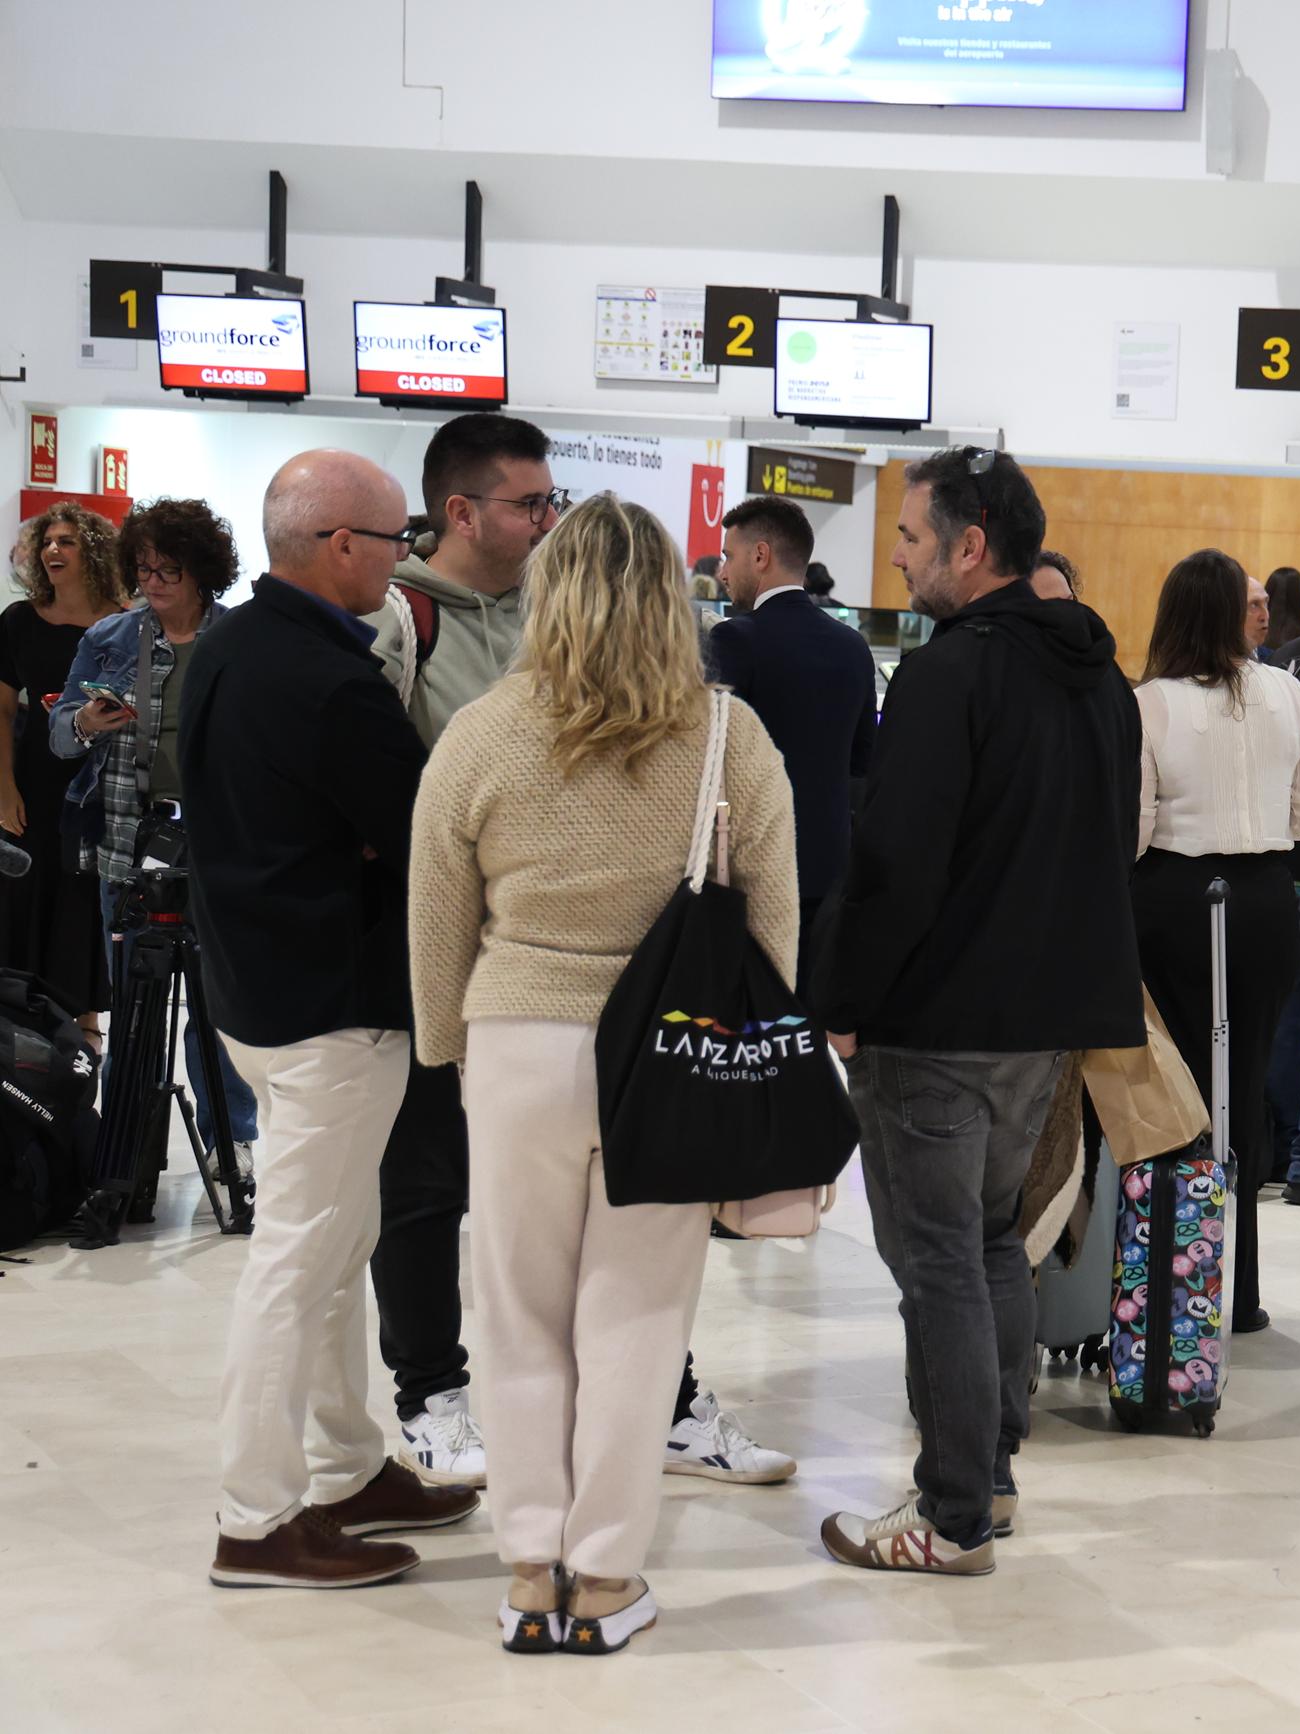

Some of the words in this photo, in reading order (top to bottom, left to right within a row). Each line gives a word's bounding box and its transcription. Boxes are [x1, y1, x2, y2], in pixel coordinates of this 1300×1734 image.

[119, 289, 137, 329] 1
[160, 327, 280, 348] groundforce
[356, 333, 481, 354] groundforce
[726, 314, 755, 357] 2
[1261, 337, 1291, 380] 3
[201, 368, 267, 387] CLOSED
[398, 374, 465, 393] CLOSED
[593, 442, 603, 462] lo
[606, 445, 638, 467] tienes
[640, 451, 663, 470] todo
[655, 1028, 815, 1066] LANZAROTE
[1, 1080, 34, 1106] HANSEN
[31, 1102, 55, 1122] HELLY
